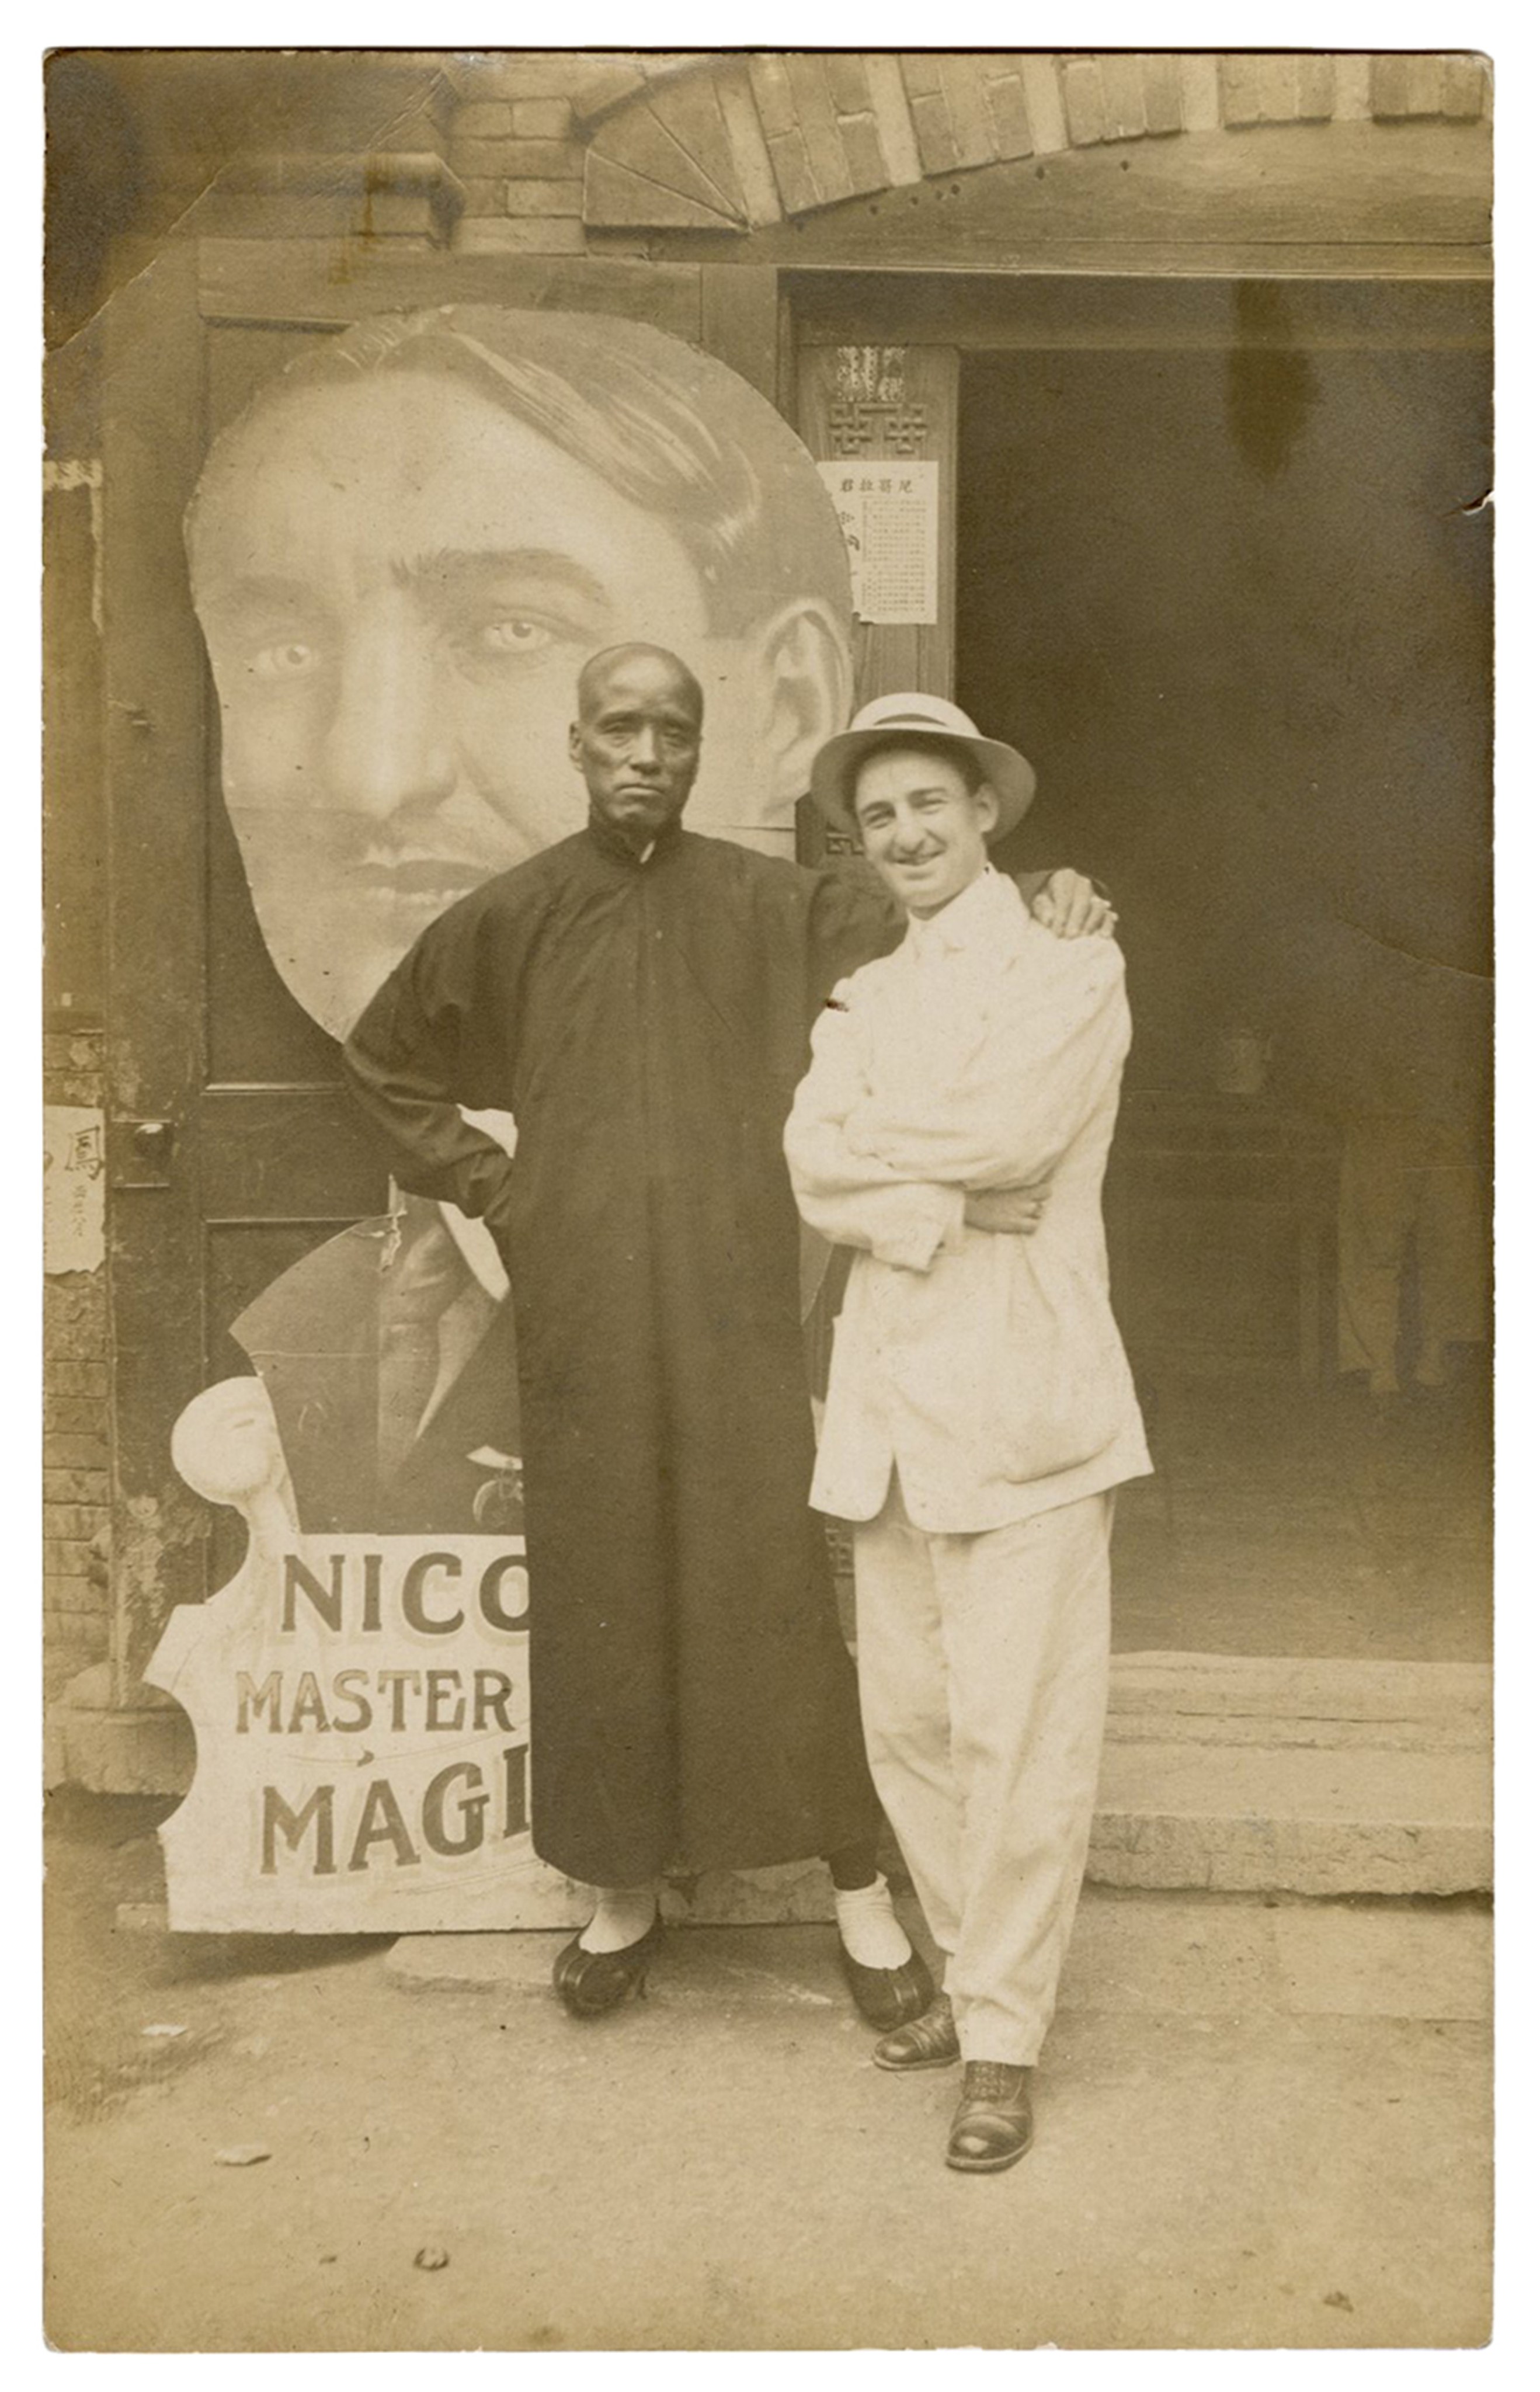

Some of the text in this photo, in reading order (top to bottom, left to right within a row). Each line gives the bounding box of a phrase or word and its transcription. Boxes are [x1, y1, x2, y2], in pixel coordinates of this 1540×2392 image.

[281, 1552, 530, 1635] NICO
[236, 1670, 515, 1733] MASTER
[260, 1744, 530, 1875] MAGI
